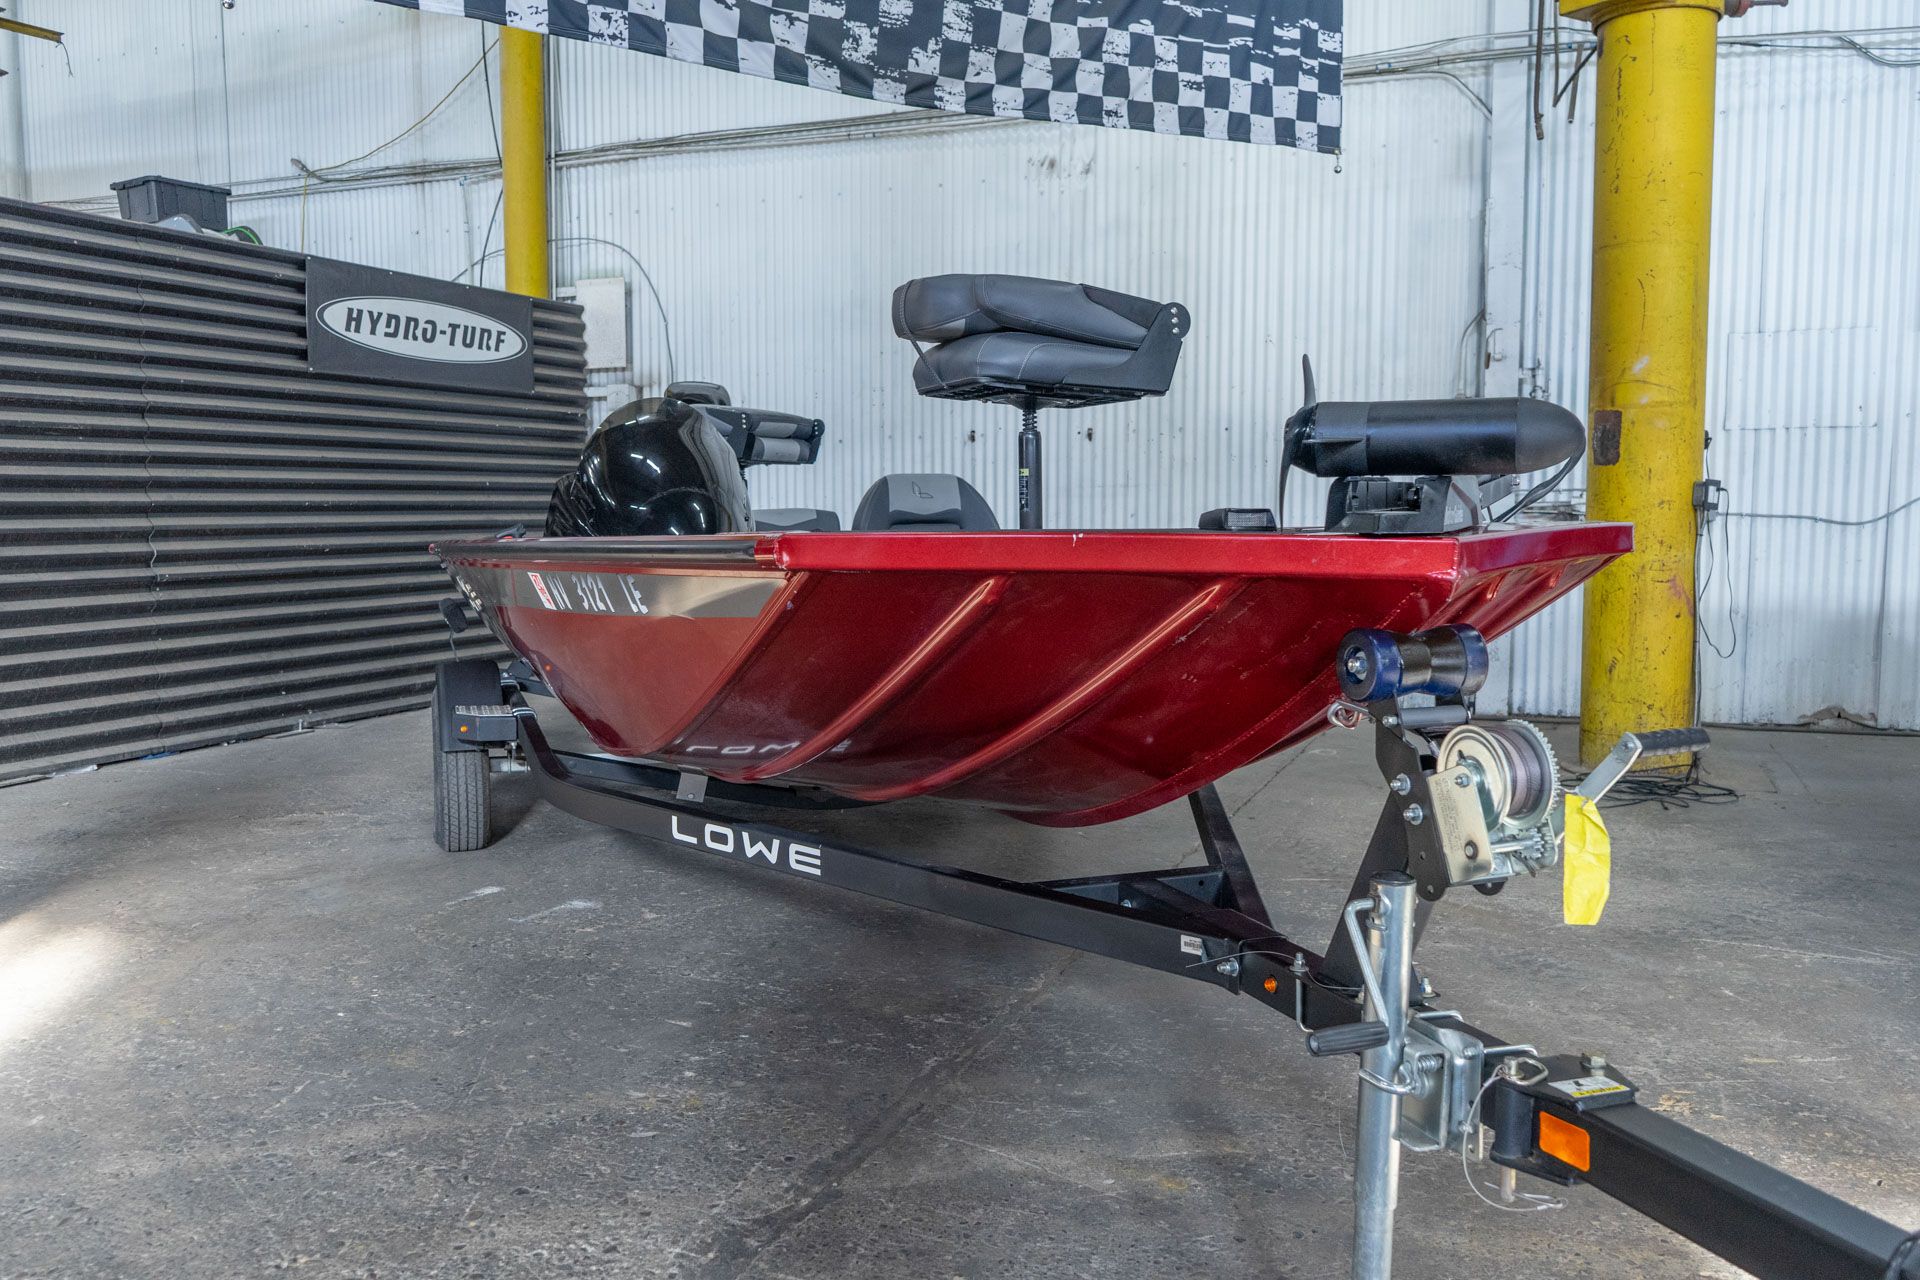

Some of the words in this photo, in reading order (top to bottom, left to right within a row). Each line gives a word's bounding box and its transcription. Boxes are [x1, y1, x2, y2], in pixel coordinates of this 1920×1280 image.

[344, 307, 507, 352] HYDRO-TURF
[546, 573, 572, 610] NV
[571, 573, 615, 613] 3121
[617, 574, 649, 614] LE
[671, 815, 821, 876] LOWE
